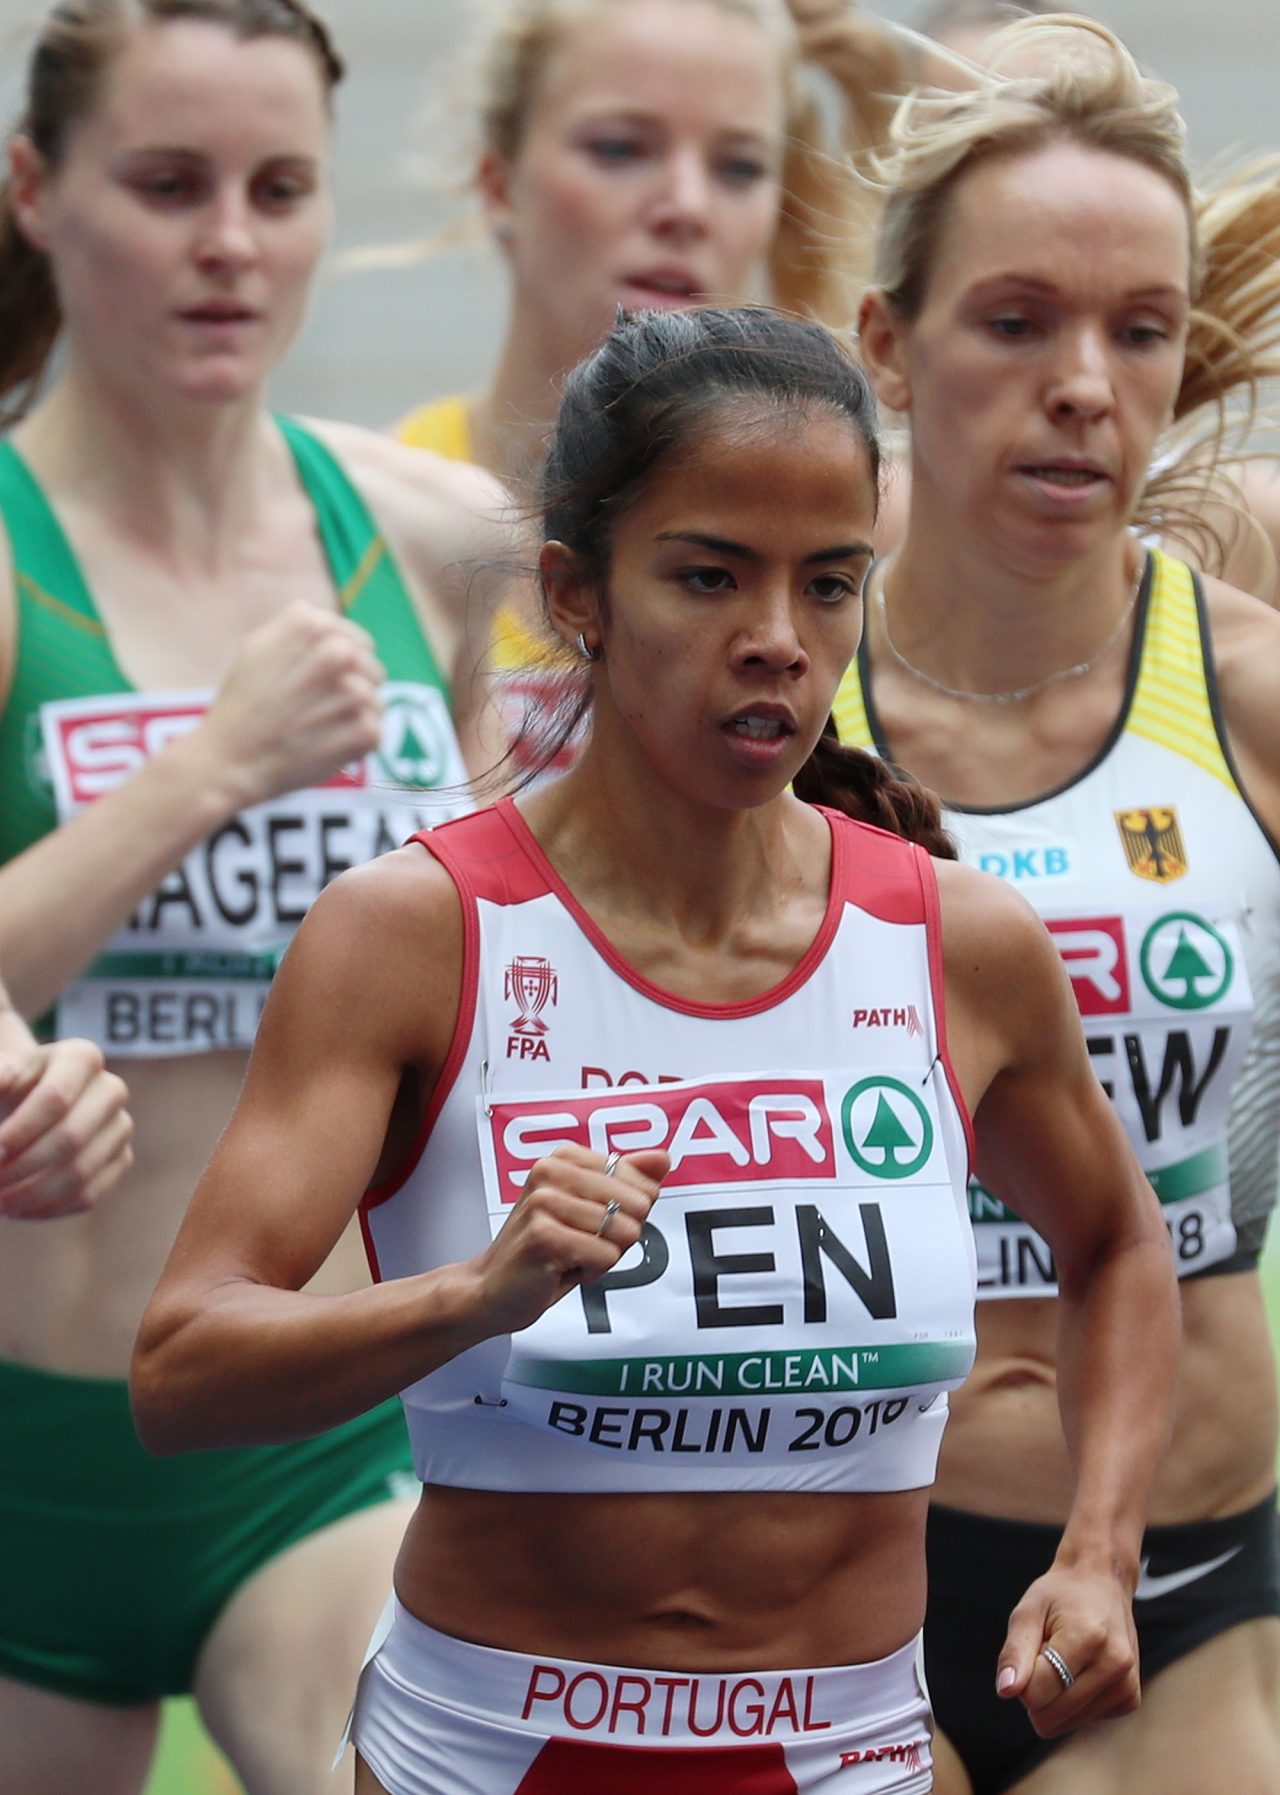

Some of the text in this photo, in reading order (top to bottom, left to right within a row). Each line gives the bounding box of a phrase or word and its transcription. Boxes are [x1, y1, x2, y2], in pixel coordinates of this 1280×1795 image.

[979, 847, 1070, 879] DKB
[506, 1036, 551, 1062] FPA
[503, 1094, 827, 1187] SPAR
[577, 1202, 898, 1335] PEN
[619, 1363, 630, 1391] I
[642, 1358, 725, 1391] RUN
[548, 1399, 771, 1453] BERLIN
[521, 1664, 832, 1737] PORTUGAL
